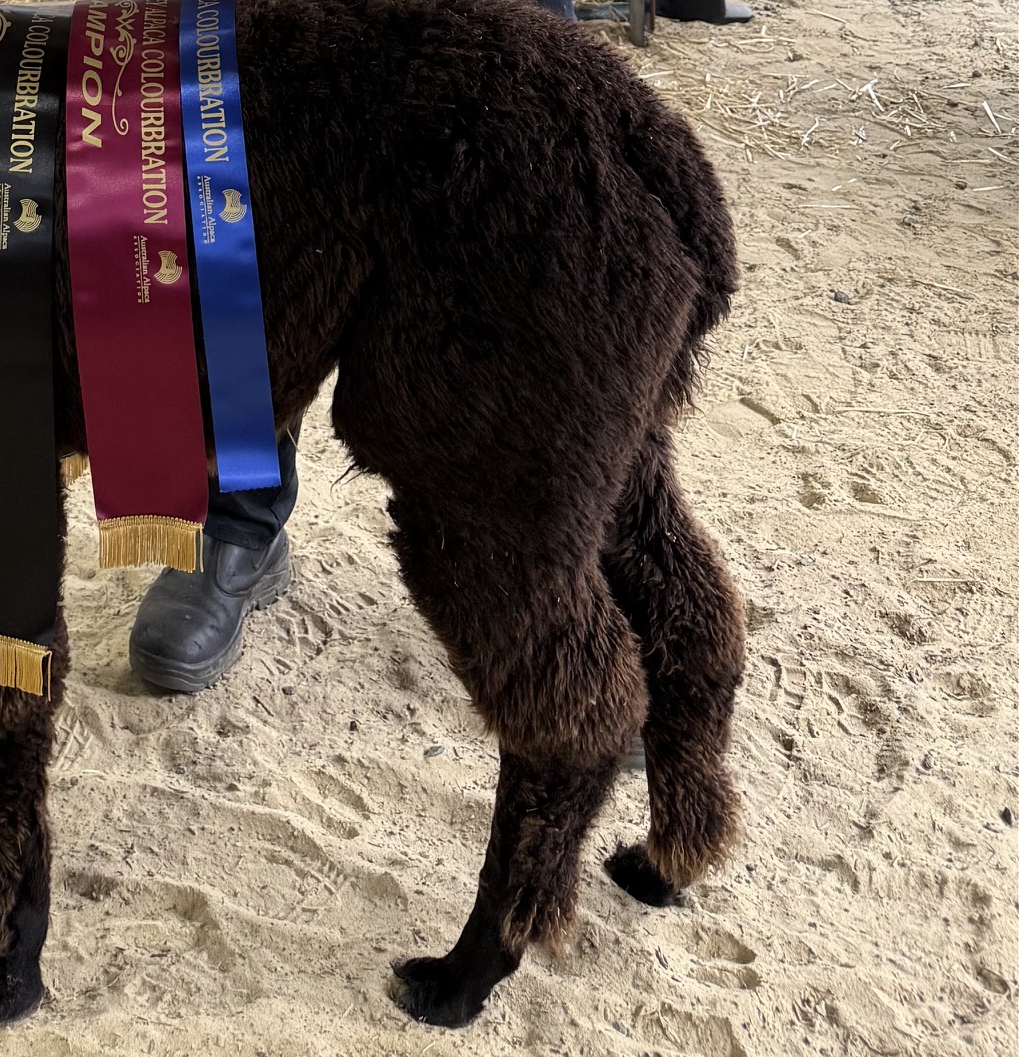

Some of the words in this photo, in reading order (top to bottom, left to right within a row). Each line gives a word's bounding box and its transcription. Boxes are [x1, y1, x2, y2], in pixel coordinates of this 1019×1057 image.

[142, 7, 168, 45] ALPACA
[9, 25, 51, 174] COLOURBRATION
[196, 9, 230, 163] COLOURBRATION
[139, 49, 168, 225] COLOURBRATION
[3, 182, 12, 222] Australian
[203, 175, 214, 215] Australian
[1, 223, 11, 250] Alpaca
[207, 216, 217, 243] Alpaca
[140, 235, 150, 275] Australian
[141, 276, 151, 303] Alpaca
